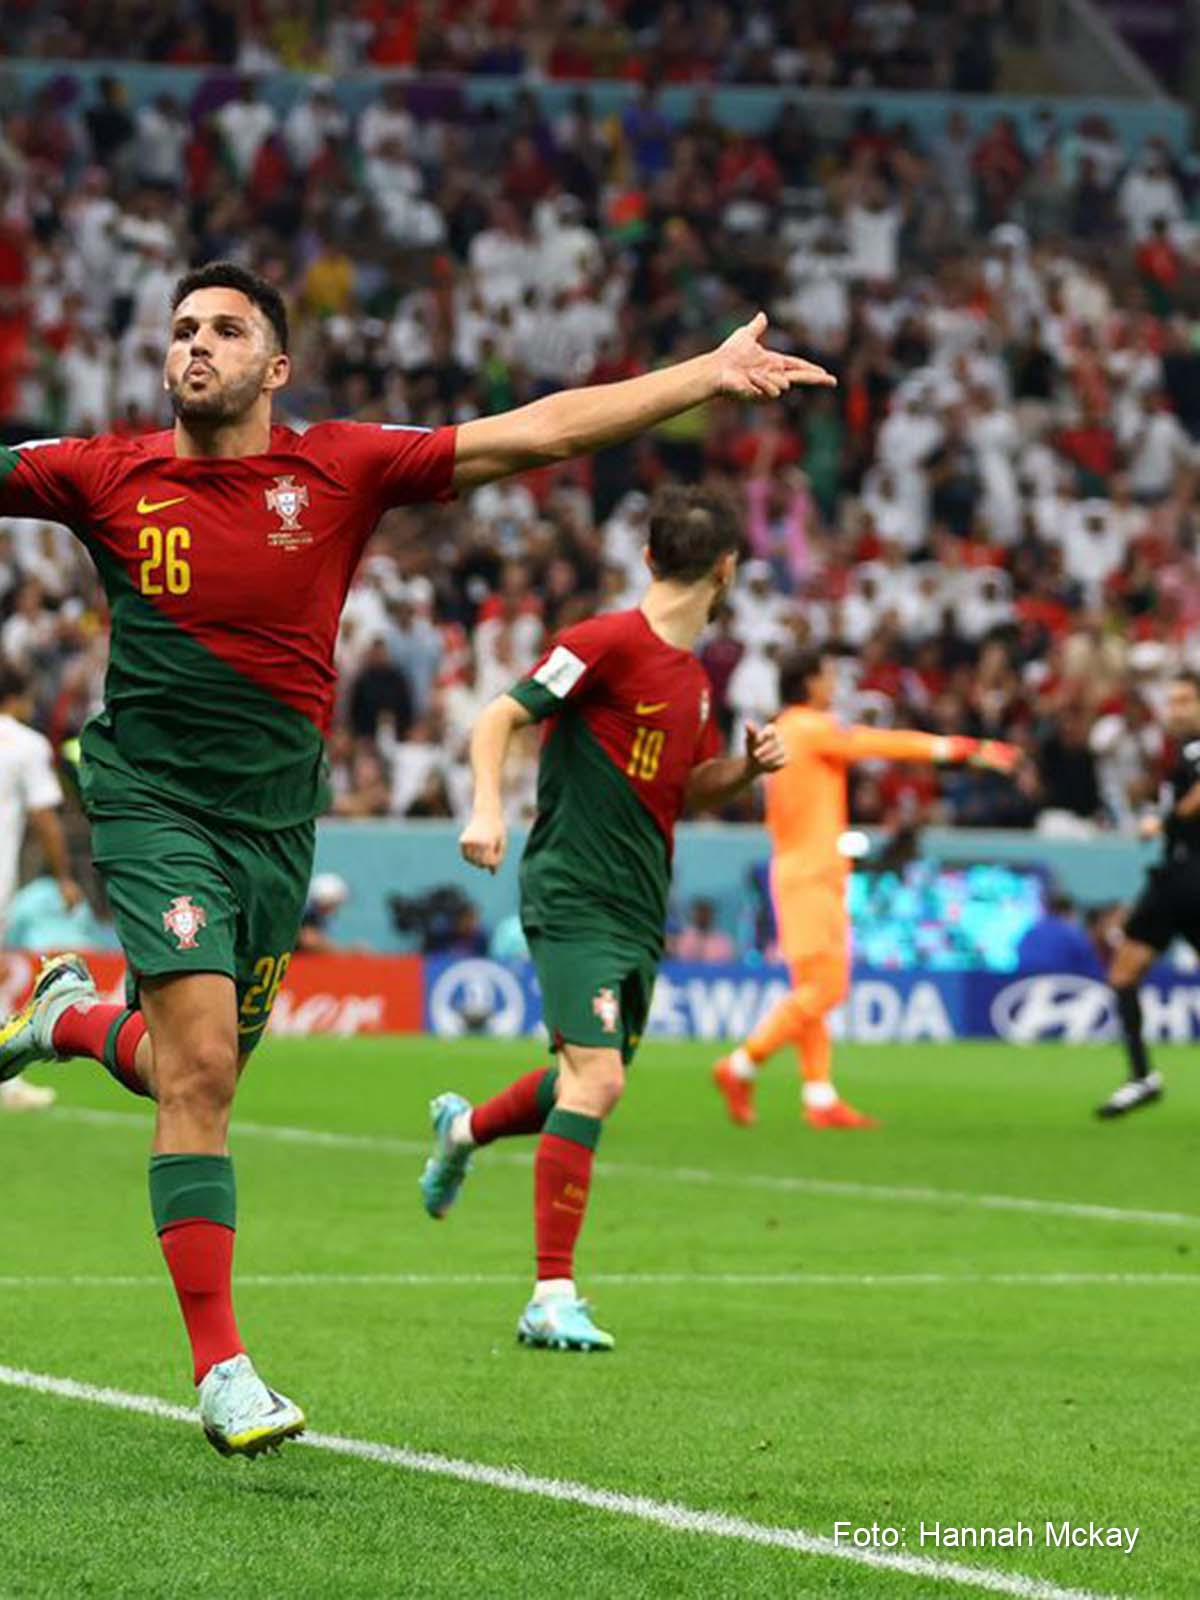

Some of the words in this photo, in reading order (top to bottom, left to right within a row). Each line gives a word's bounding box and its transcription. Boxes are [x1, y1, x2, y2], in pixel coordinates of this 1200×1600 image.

[138, 526, 192, 596] 26
[626, 727, 666, 781] 10
[686, 978, 958, 1038] WADA
